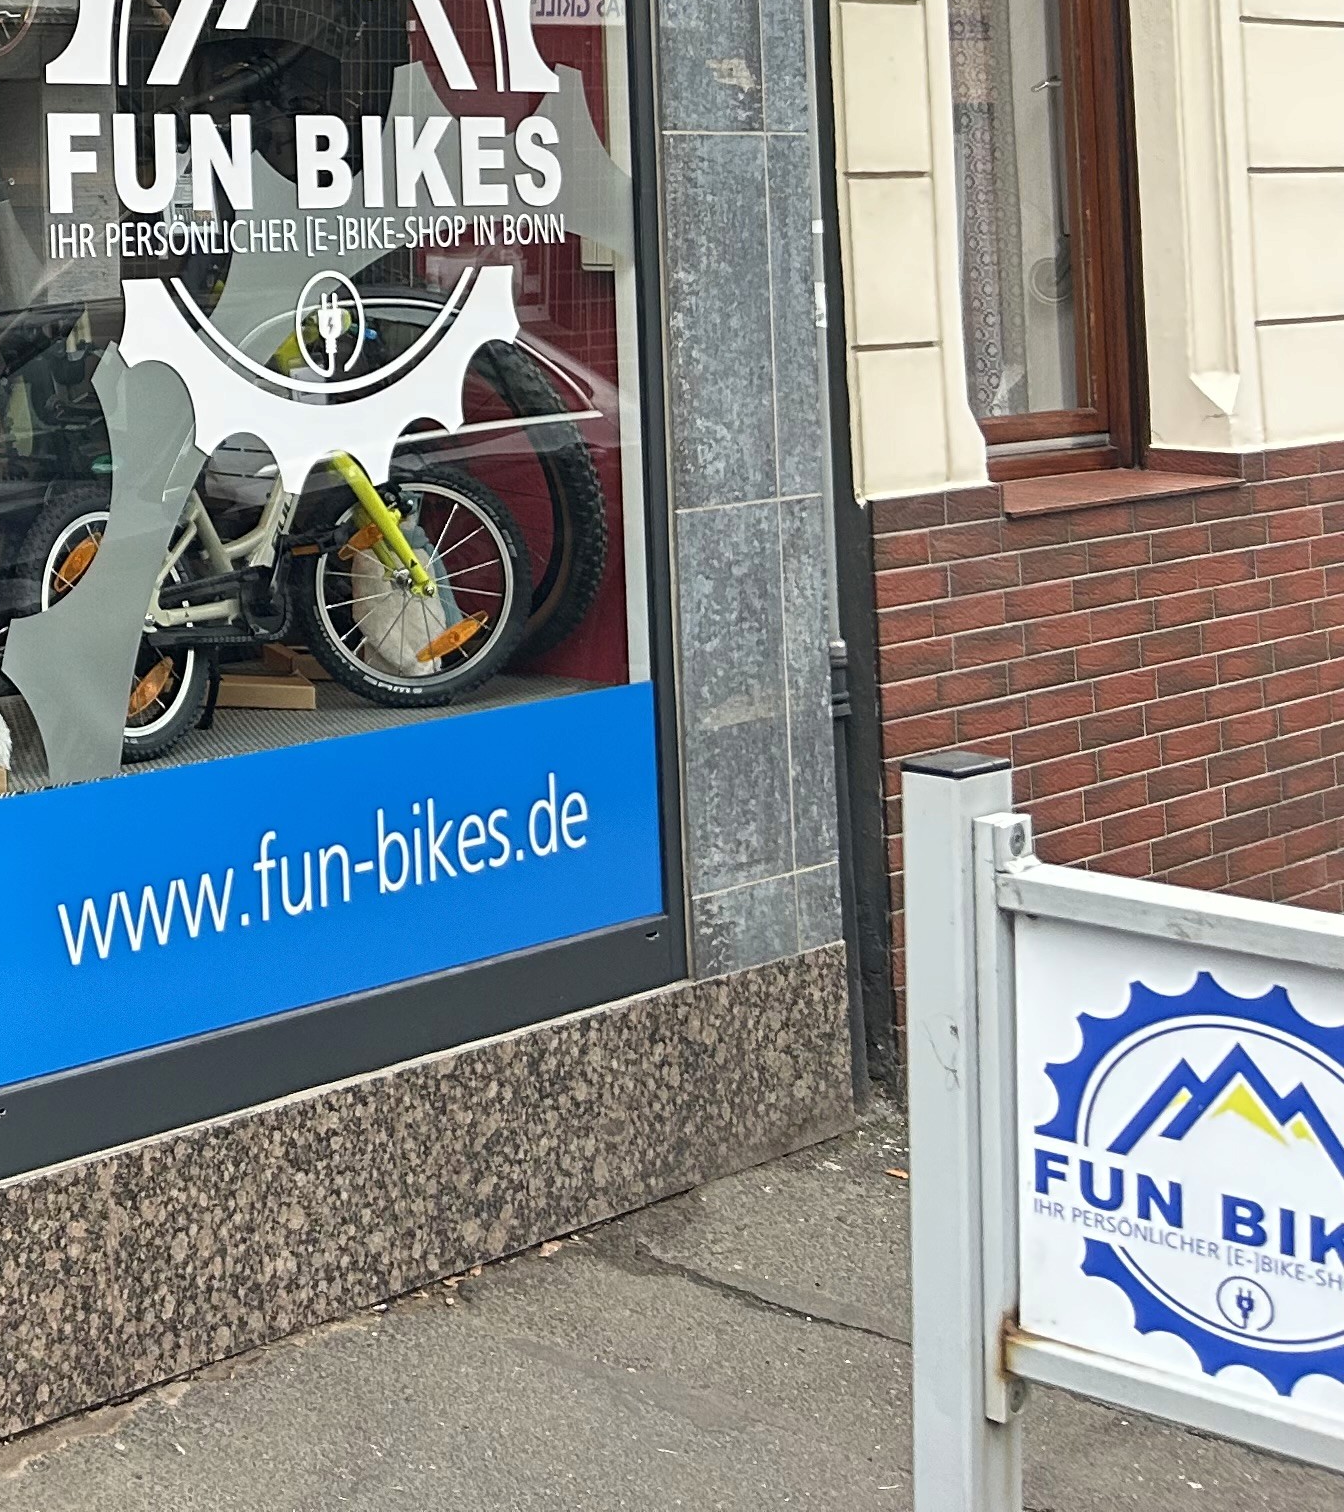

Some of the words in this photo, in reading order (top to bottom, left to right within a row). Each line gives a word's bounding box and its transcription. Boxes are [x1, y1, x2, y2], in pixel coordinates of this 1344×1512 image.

[46, 112, 252, 214] FUN
[294, 113, 563, 210] BIKES
[49, 220, 98, 259] IHR
[105, 213, 300, 257] PERSÖNLICHER
[306, 214, 467, 256] [E-]BIKE-SHOP
[472, 215, 499, 246] IN
[503, 213, 566, 245] BONN
[57, 772, 589, 966] www.fun-bikes.de
[1034, 1148, 1184, 1230] FUN
[1033, 1197, 1064, 1221] IHR
[1071, 1206, 1220, 1260] PERSÖNLICHER
[1226, 1246, 1344, 1292] [E-]BIKE-SH
